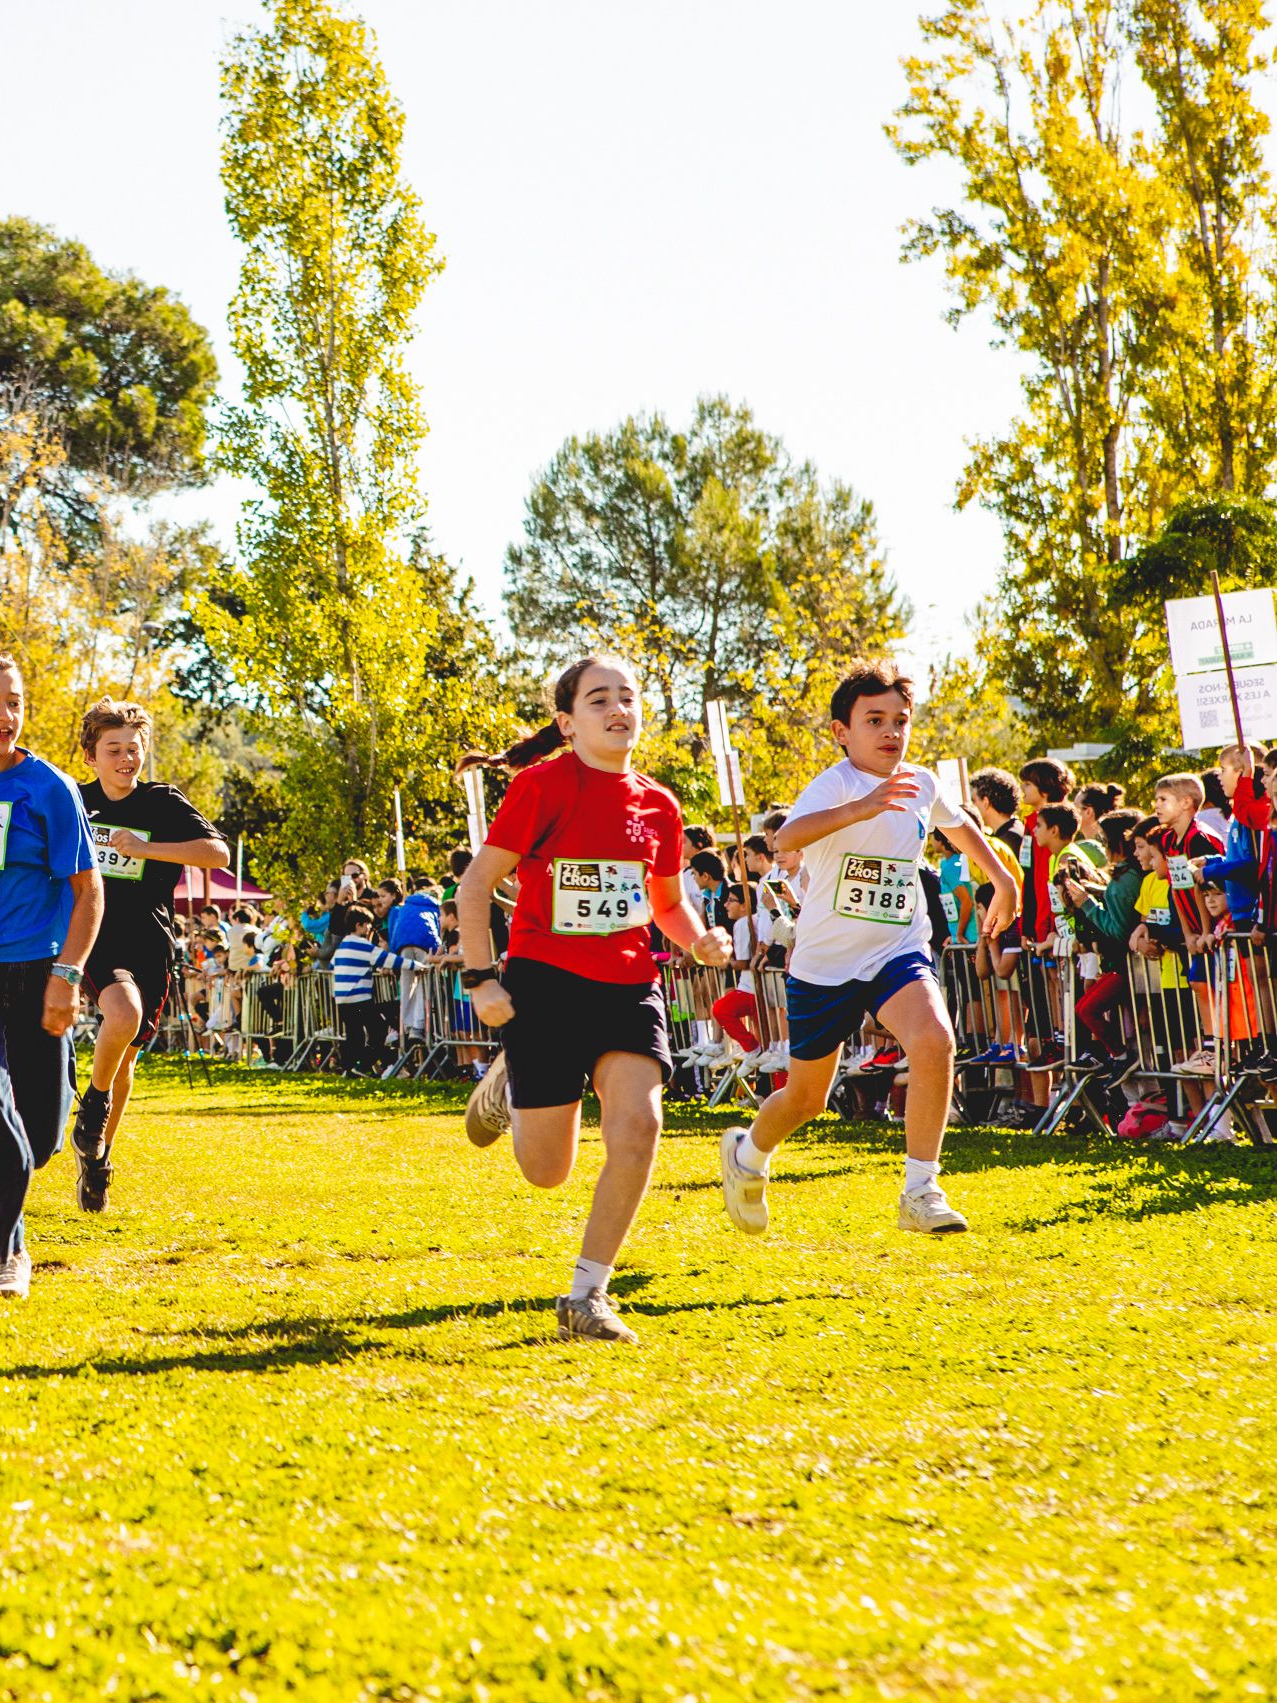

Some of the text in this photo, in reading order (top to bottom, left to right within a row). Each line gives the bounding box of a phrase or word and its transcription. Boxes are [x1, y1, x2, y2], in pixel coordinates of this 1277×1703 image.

[562, 875, 600, 887] CROS
[847, 867, 880, 880] CROS
[849, 888, 906, 910] 3188
[577, 899, 628, 917] 549
